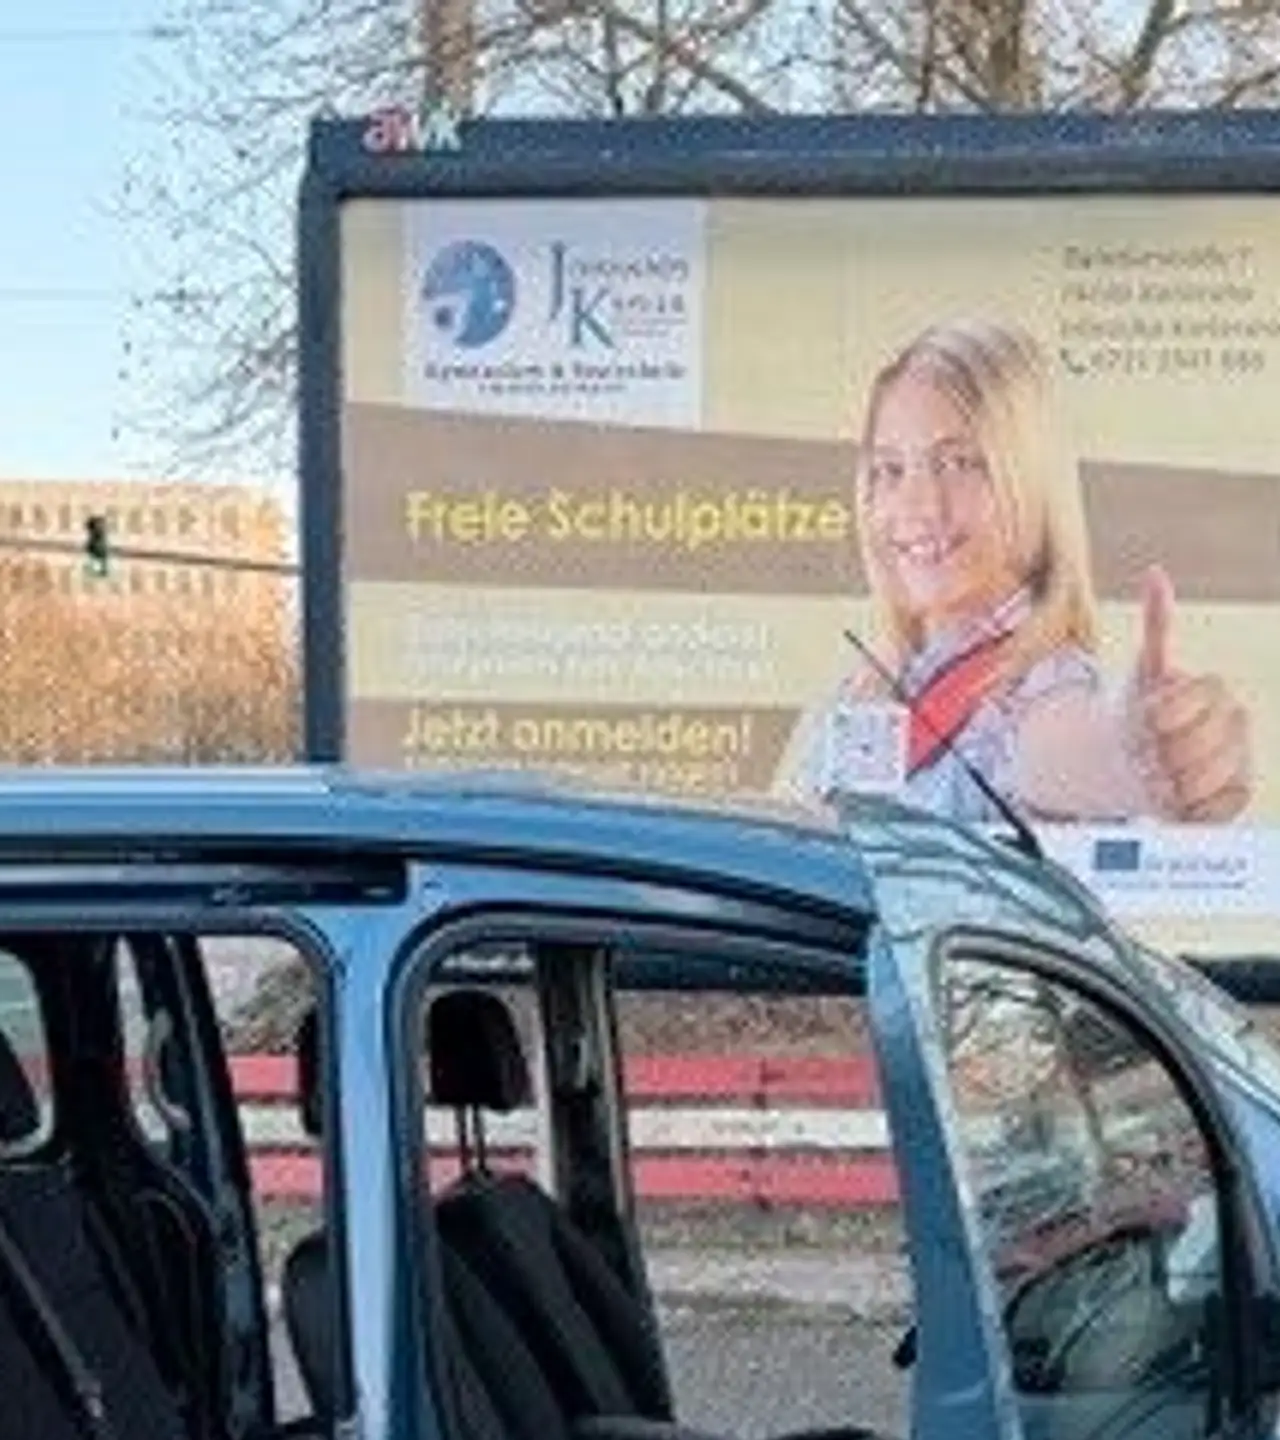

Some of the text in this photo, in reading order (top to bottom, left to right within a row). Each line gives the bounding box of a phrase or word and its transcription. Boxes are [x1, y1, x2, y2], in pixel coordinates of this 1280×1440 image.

[404, 487, 851, 551] Freie Schulplätze
[403, 706, 753, 758] Jetzt anmelden!
